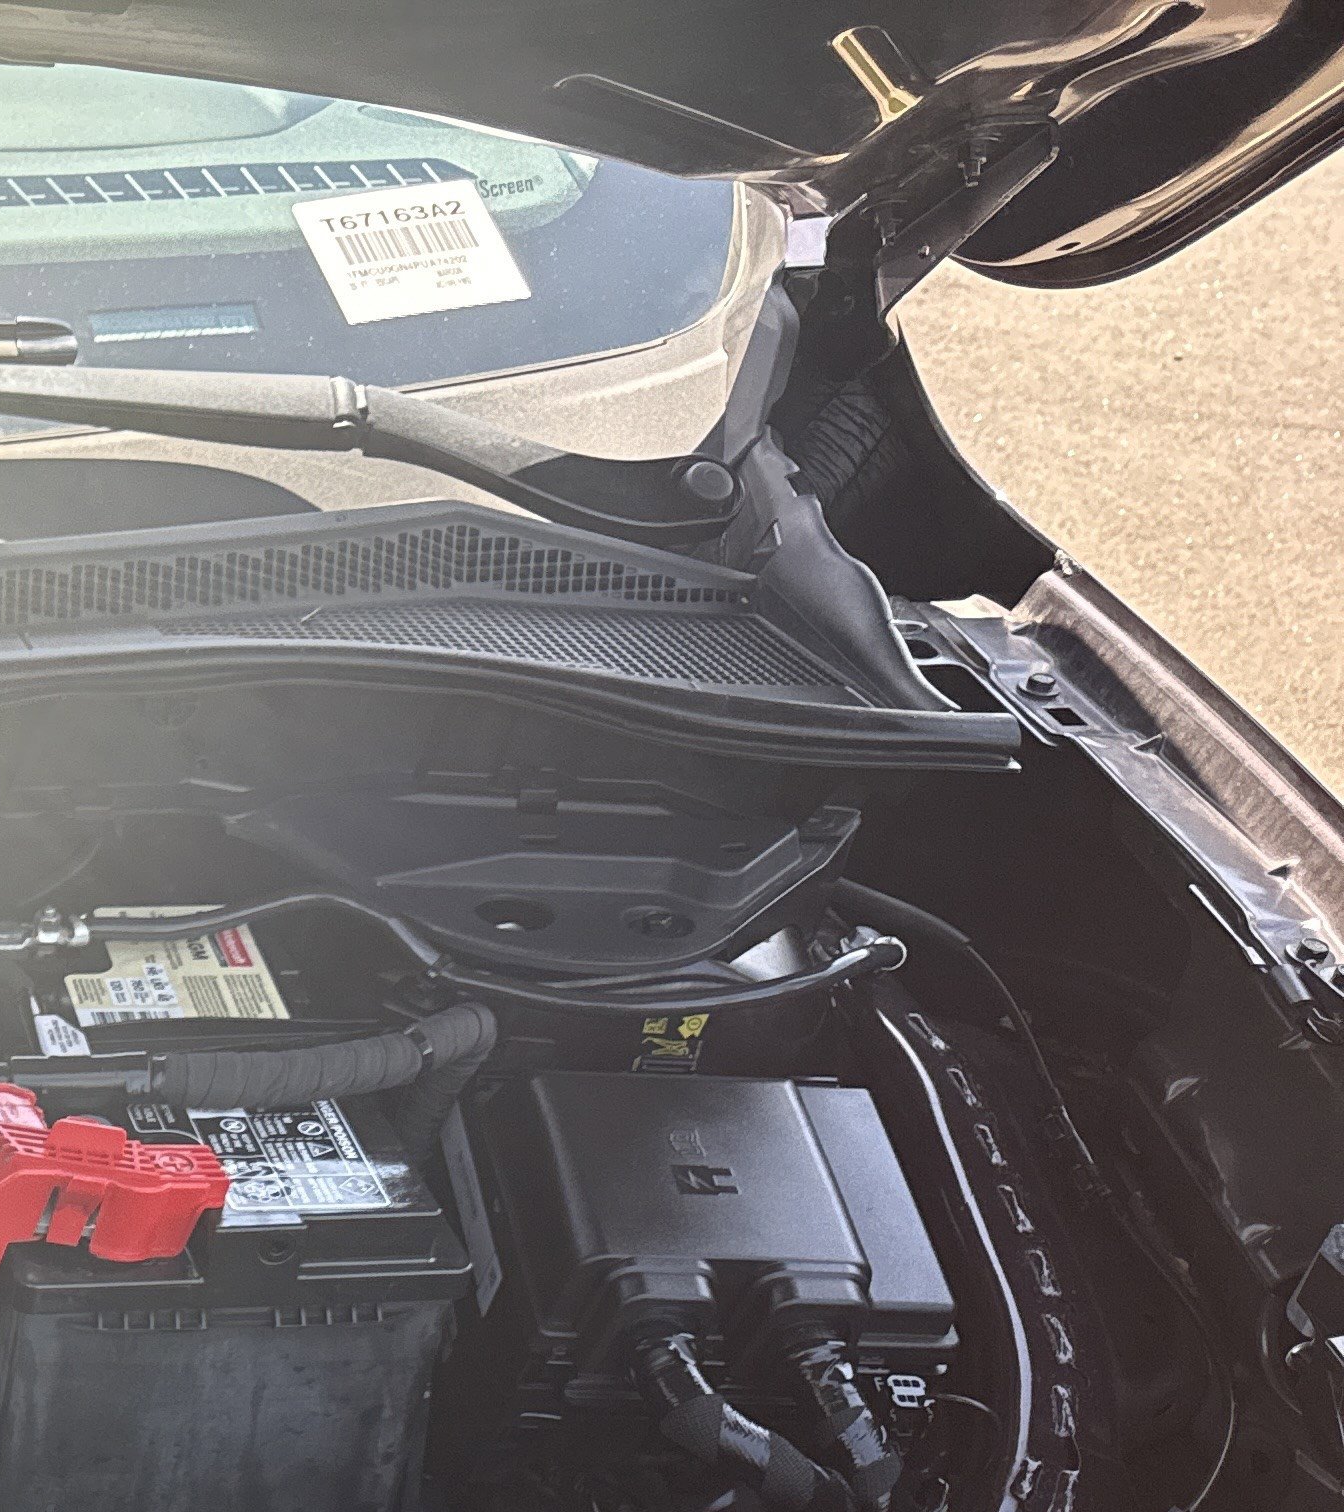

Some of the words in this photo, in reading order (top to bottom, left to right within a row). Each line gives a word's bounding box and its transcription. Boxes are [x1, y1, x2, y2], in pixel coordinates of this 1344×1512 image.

[474, 174, 543, 199] Screen®
[320, 200, 466, 234] T67163A2
[330, 1123, 359, 1159] POISON
